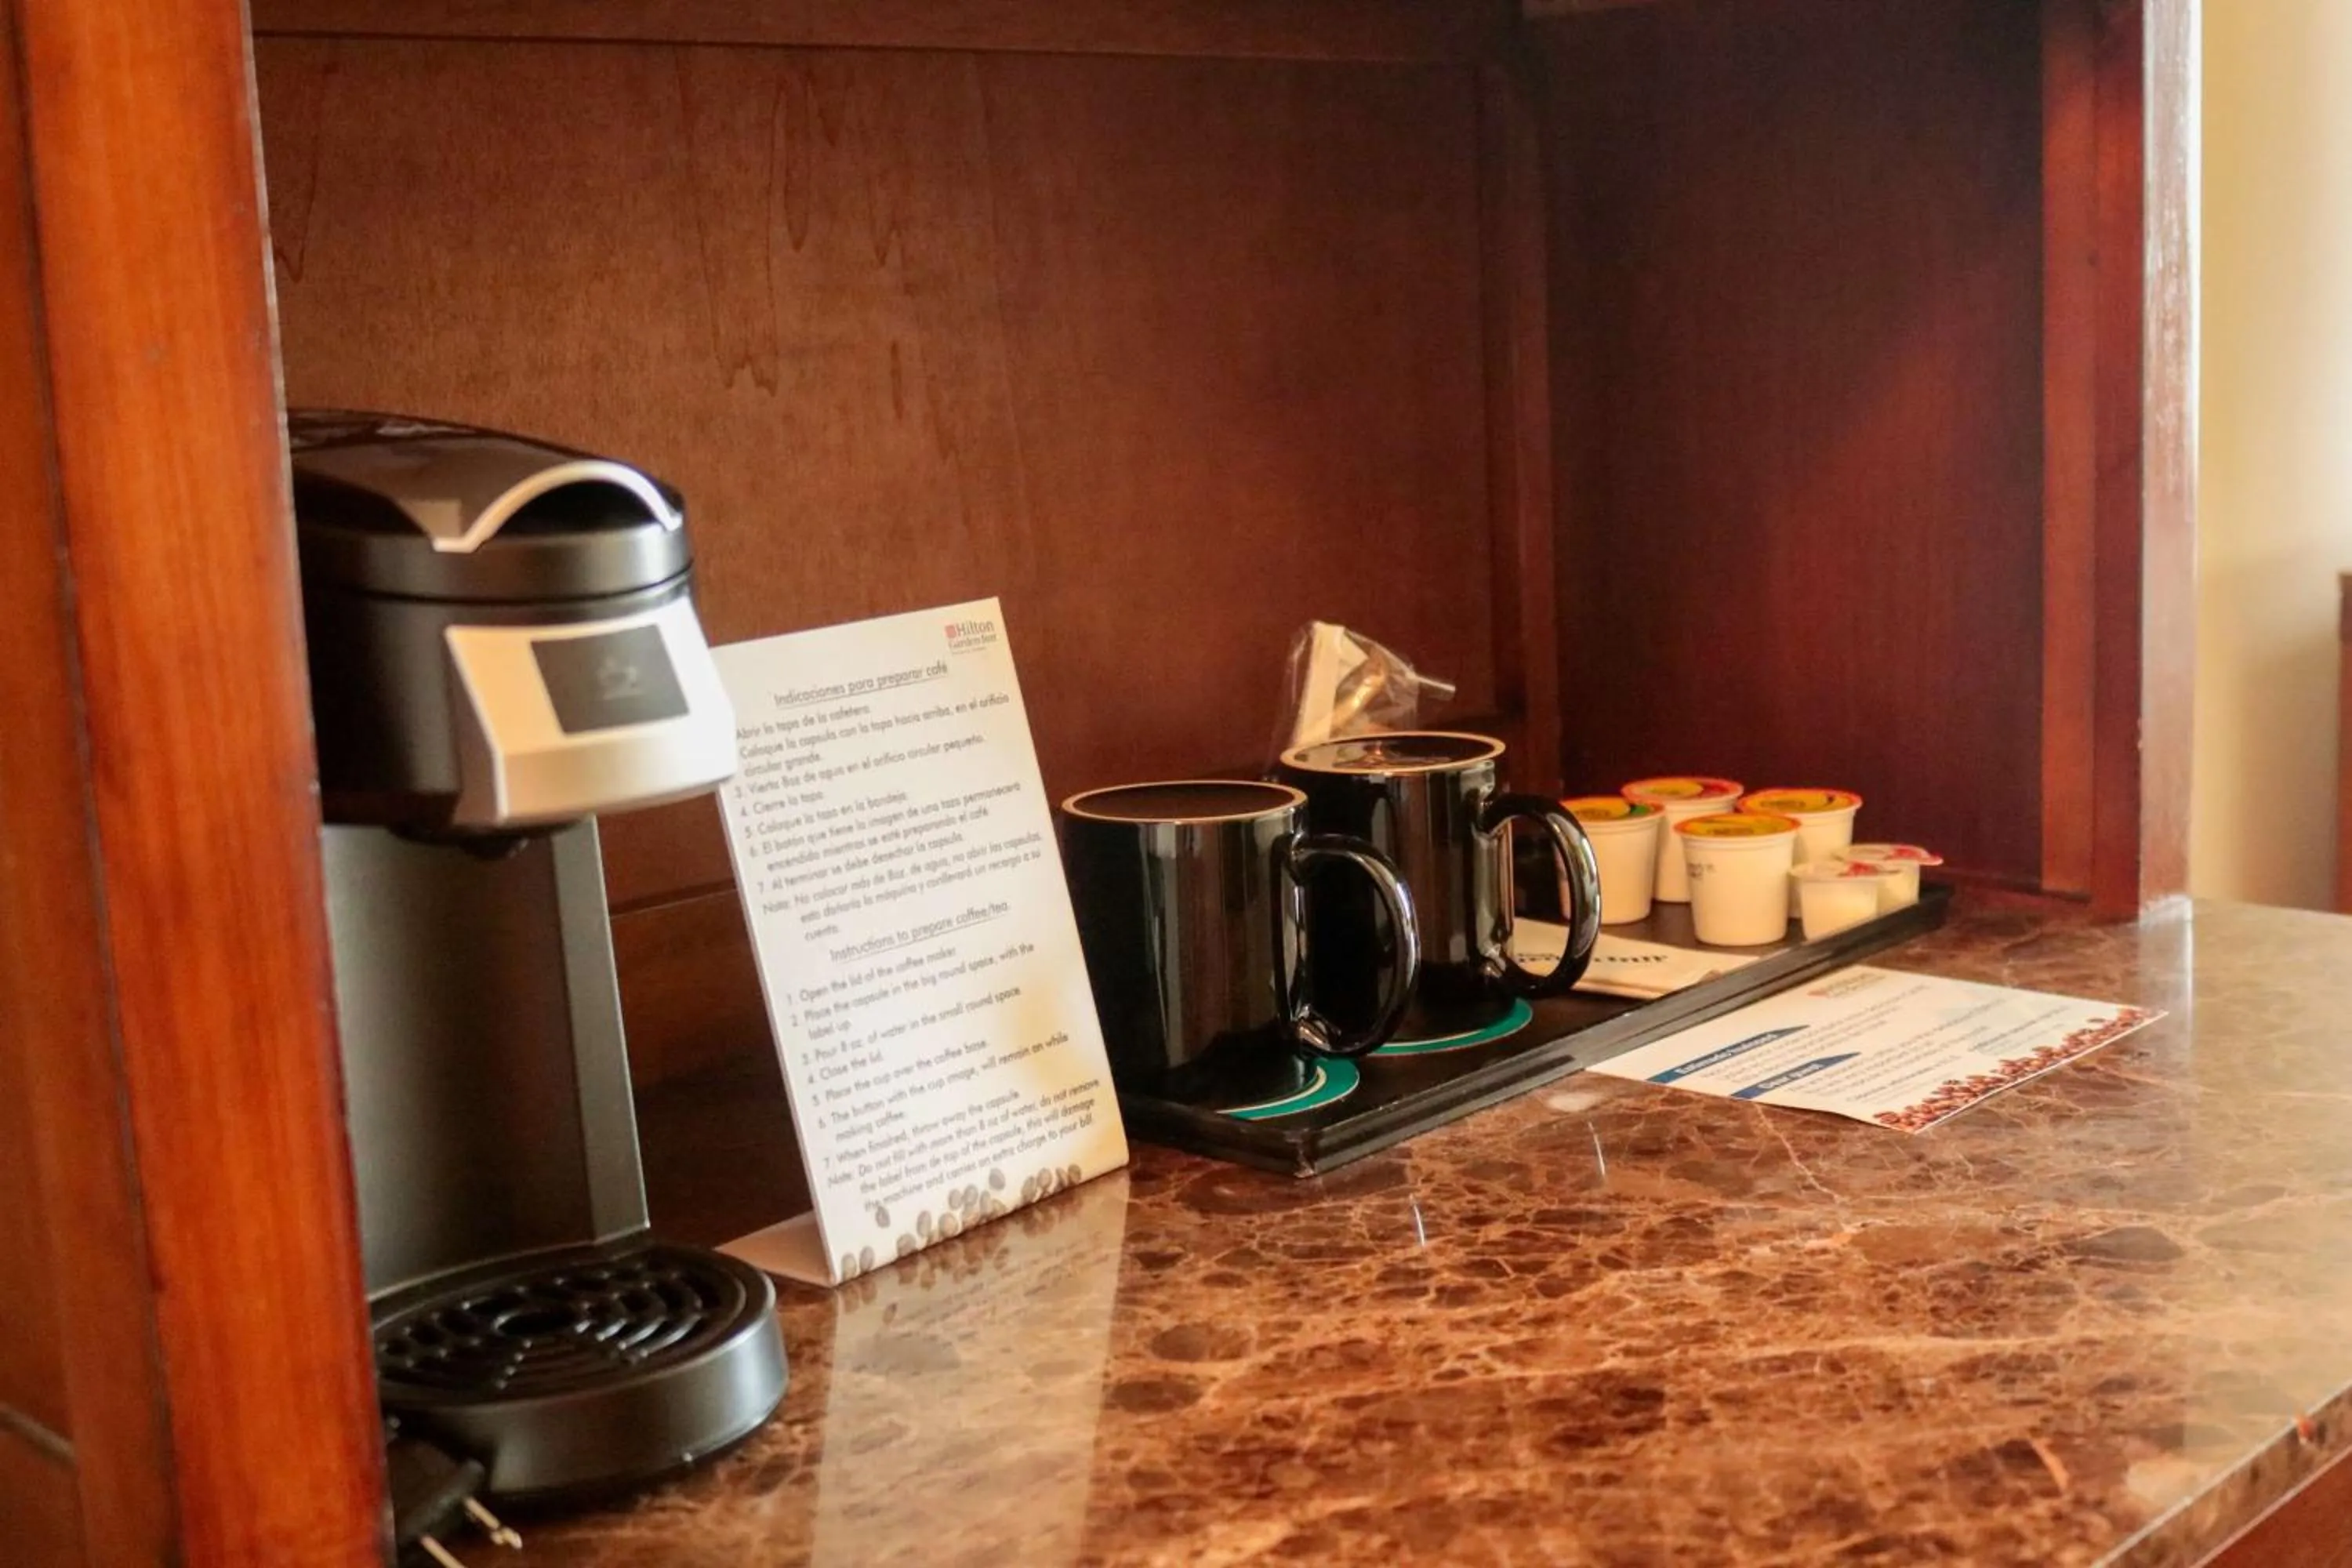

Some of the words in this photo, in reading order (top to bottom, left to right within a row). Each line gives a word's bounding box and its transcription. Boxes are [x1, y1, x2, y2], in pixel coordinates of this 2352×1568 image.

[956, 620, 994, 637] Hilton
[774, 684, 845, 706] Indicaciones
[848, 678, 873, 695] para
[877, 669, 924, 690] preparar
[926, 660, 948, 677] café
[829, 934, 894, 961] Instructions
[911, 917, 952, 942] prepare
[830, 978, 848, 992] the
[876, 964, 893, 978] the
[833, 998, 849, 1014] the
[902, 977, 919, 992] the
[920, 1011, 937, 1027] the
[849, 1054, 866, 1070] the
[854, 1077, 871, 1092] the
[915, 1056, 932, 1071] the
[908, 1083, 925, 1097] the
